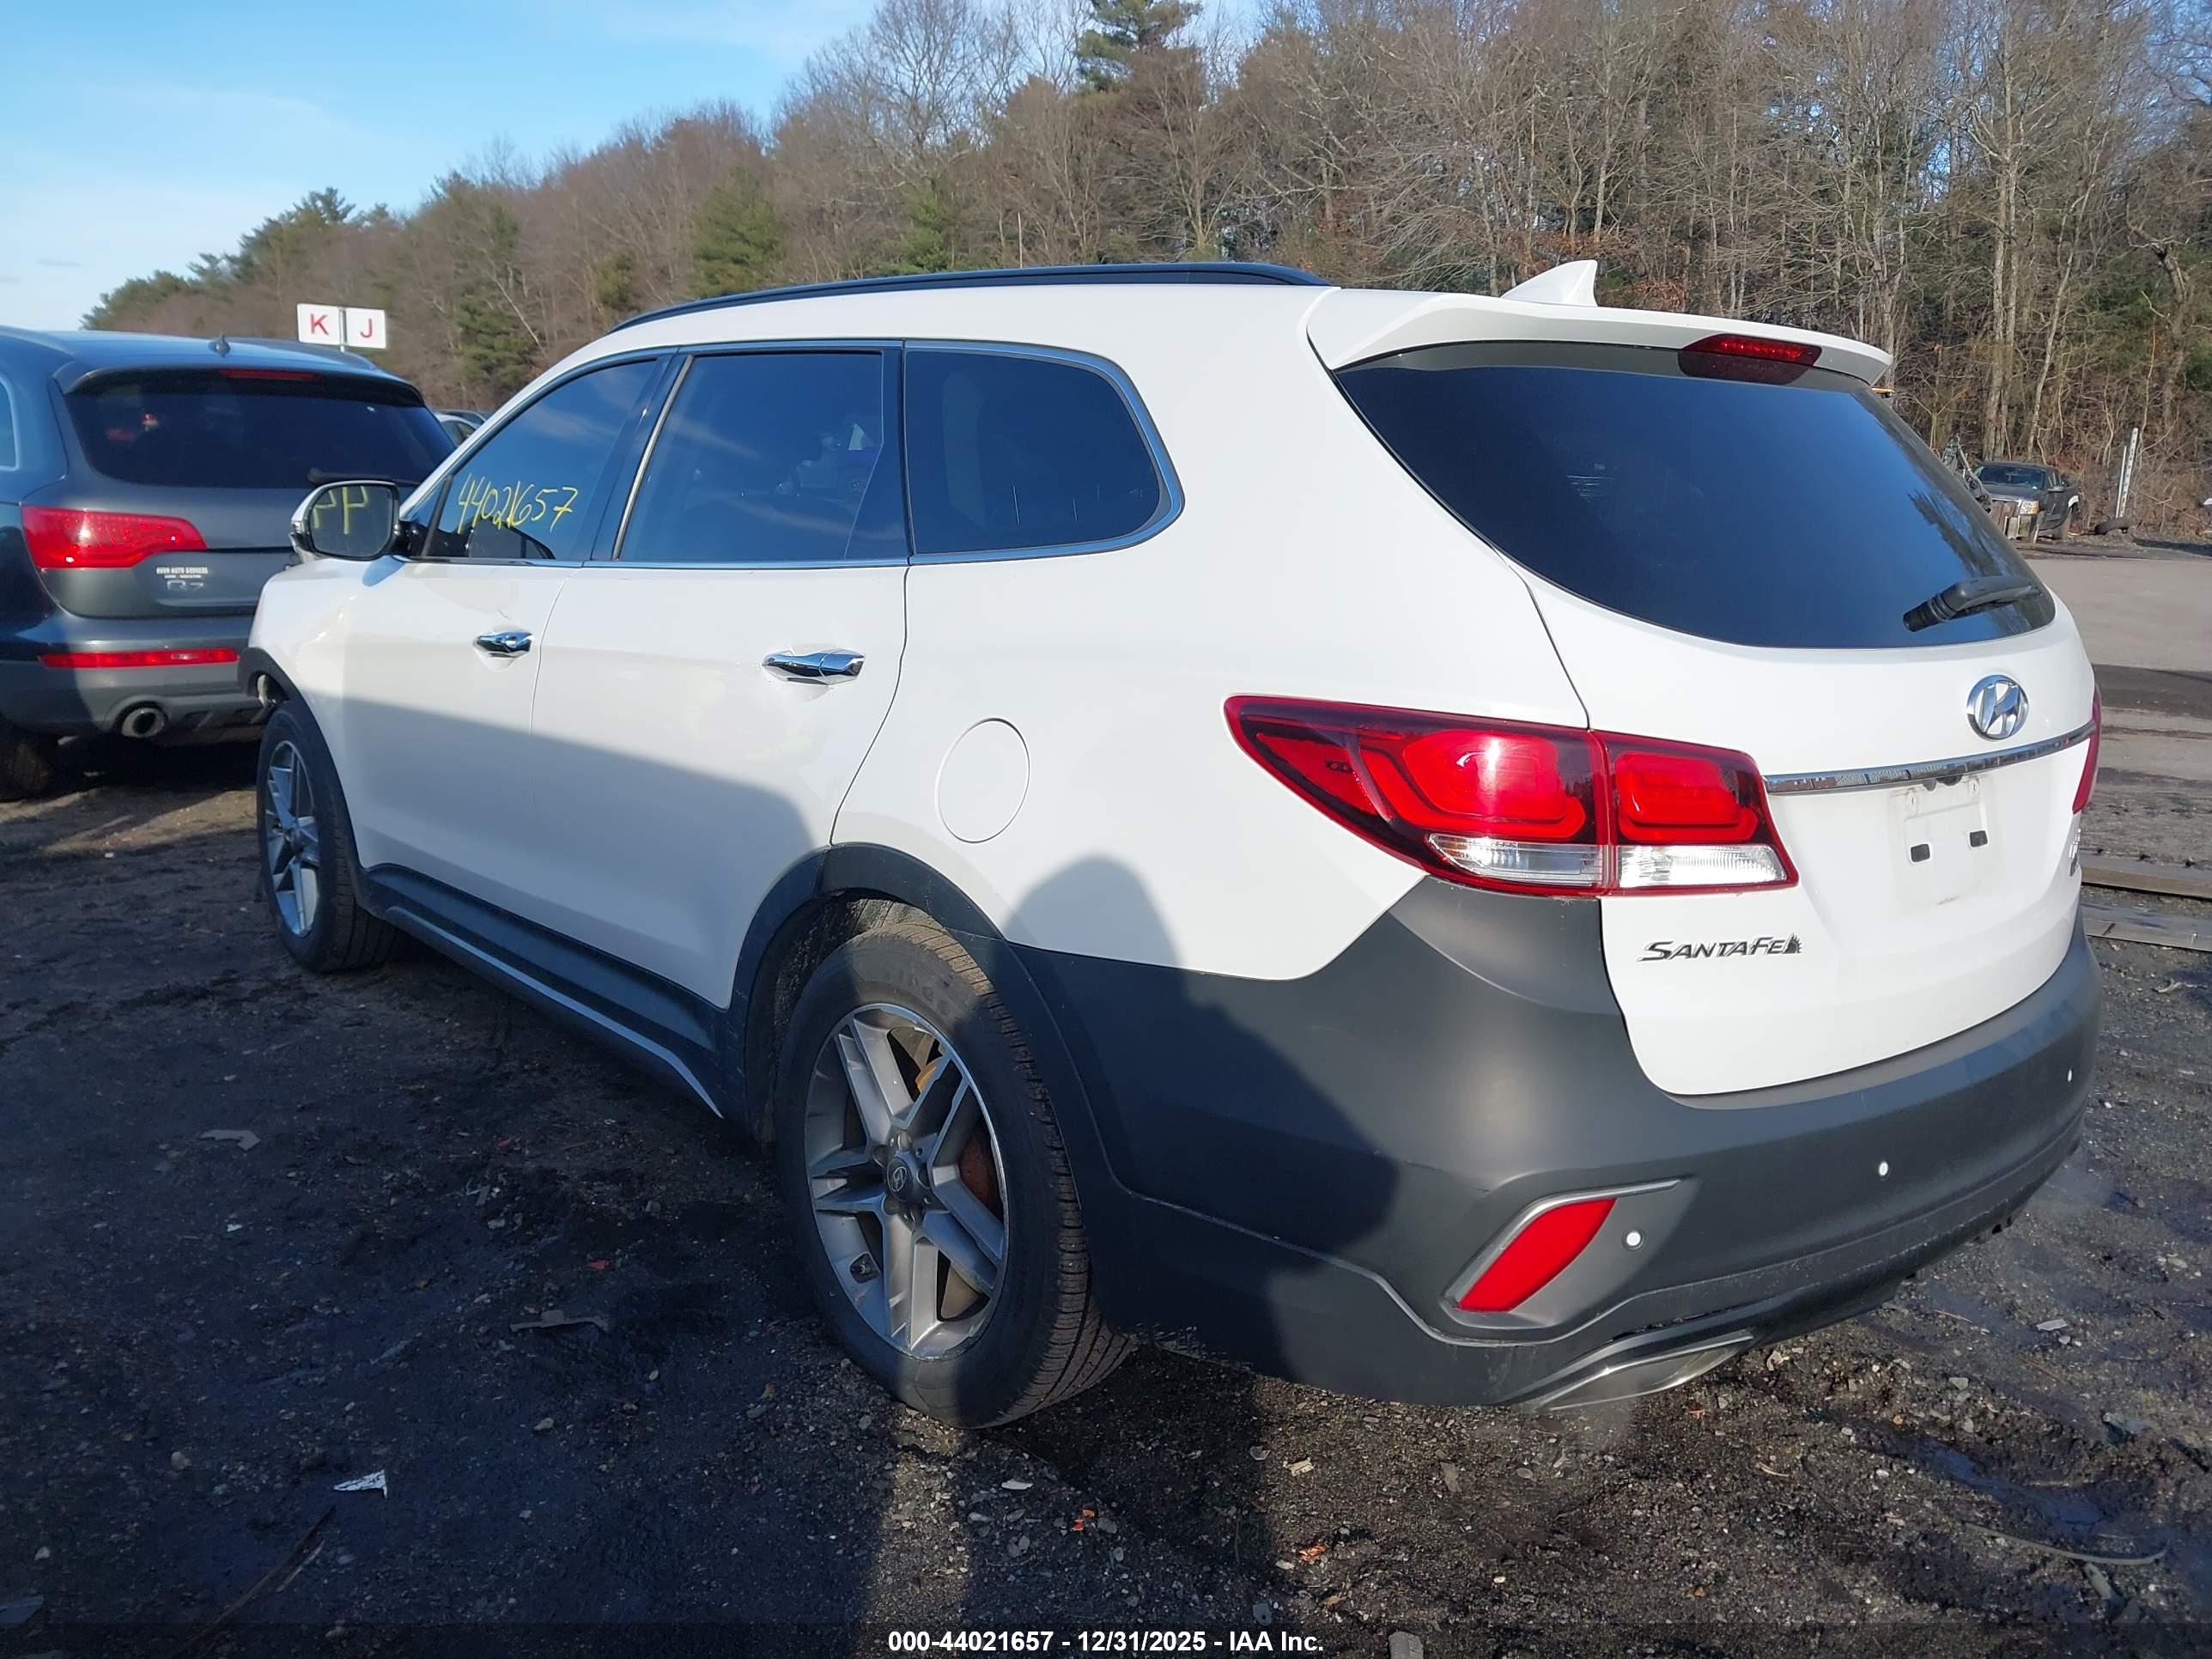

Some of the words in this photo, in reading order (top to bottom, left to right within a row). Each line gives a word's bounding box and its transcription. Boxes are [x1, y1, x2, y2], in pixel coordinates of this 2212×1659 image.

[310, 313, 330, 336] K
[360, 319, 373, 338] J
[457, 473, 579, 535] 44021657
